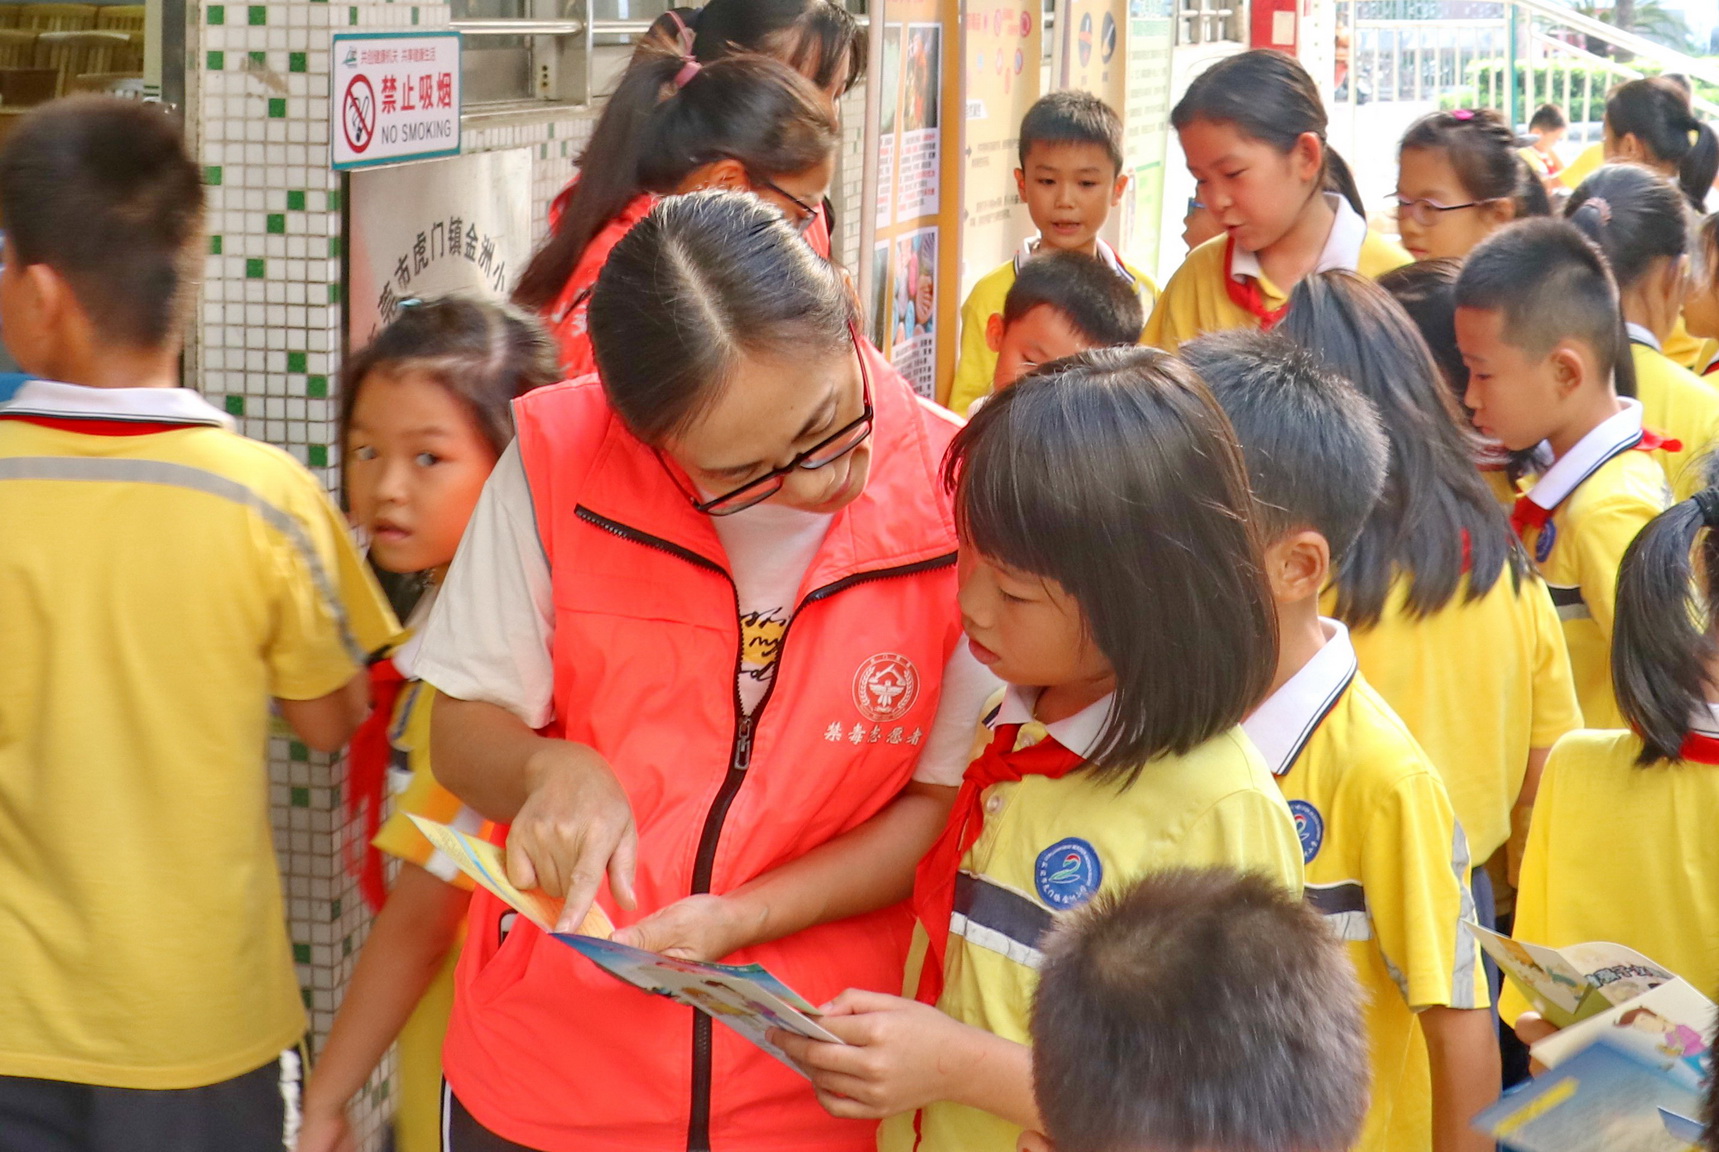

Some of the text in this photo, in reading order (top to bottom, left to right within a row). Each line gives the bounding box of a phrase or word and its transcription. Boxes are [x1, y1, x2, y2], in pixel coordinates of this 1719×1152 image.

[381, 72, 452, 115] 禁止吸烟
[381, 119, 452, 144] NO SMOKING
[368, 216, 507, 346] 莞市虎门镇金洲小
[823, 721, 924, 746] 禁毒志愿者
